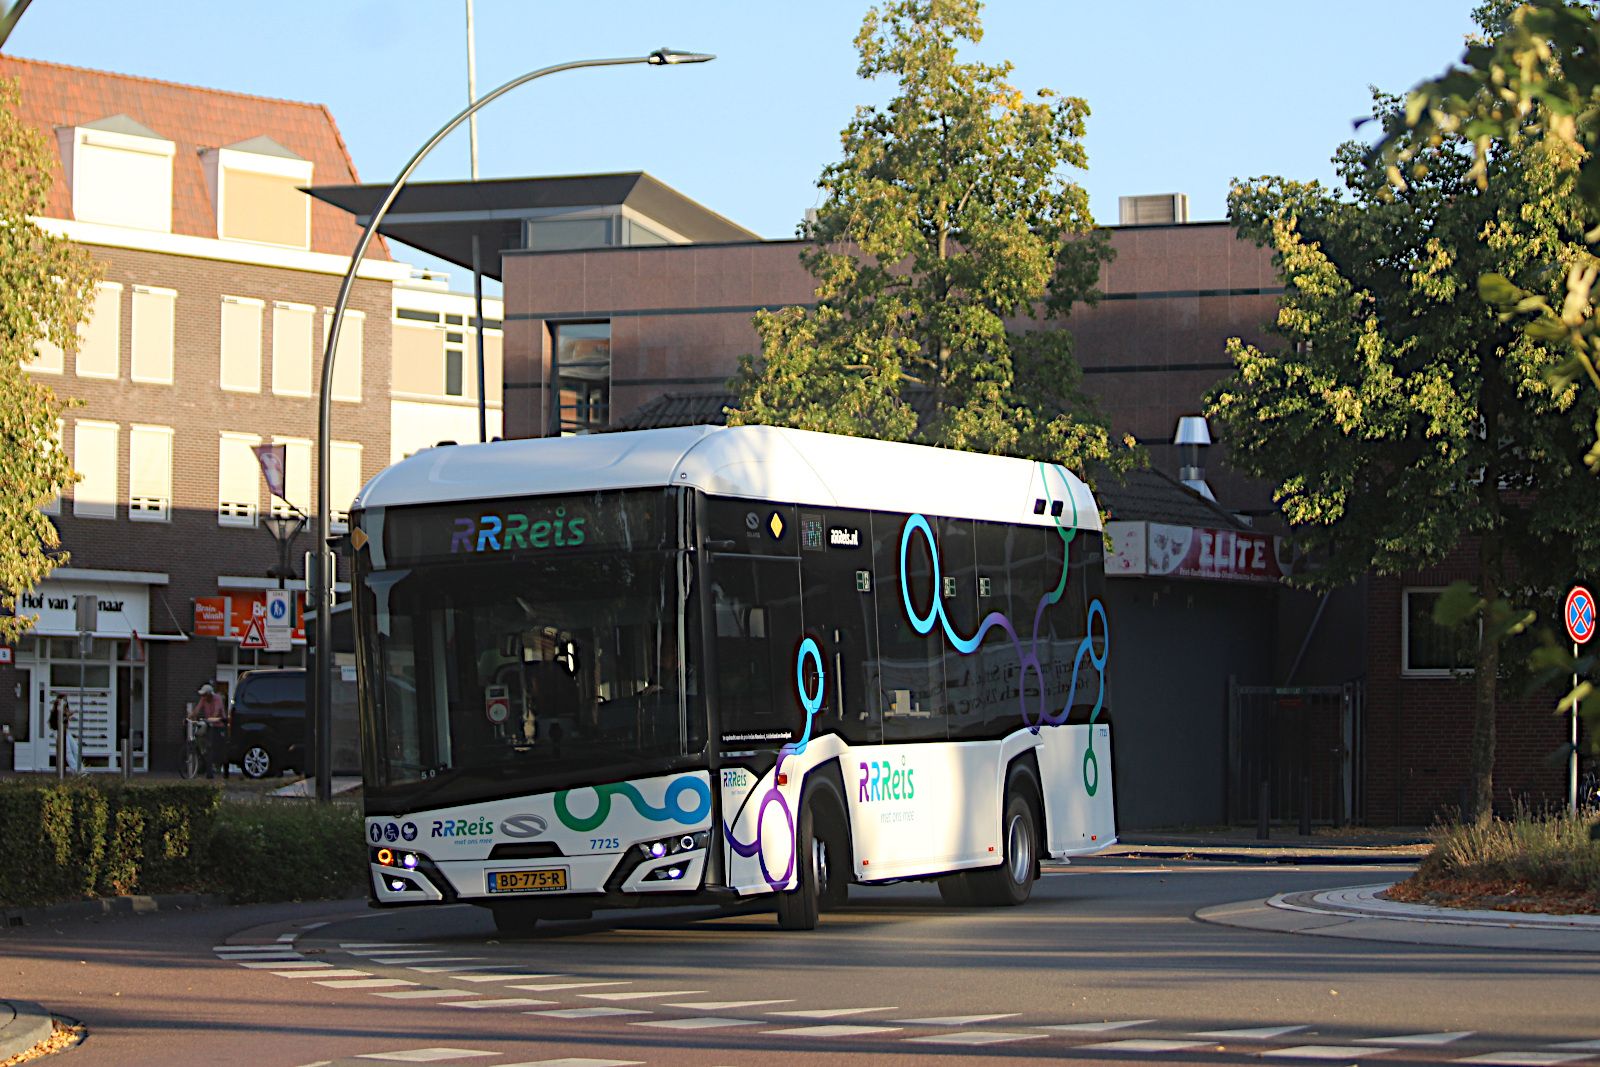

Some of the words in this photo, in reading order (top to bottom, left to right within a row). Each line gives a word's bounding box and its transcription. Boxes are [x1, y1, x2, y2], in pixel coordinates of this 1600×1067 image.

[450, 506, 586, 553] RRReis
[1199, 531, 1267, 569] ELITE
[22, 591, 44, 609] Hof
[48, 597, 69, 610] van
[196, 603, 216, 612] Brain
[202, 610, 224, 620] Wash
[723, 768, 747, 787] RRReis
[859, 754, 915, 803] RRReis
[880, 812, 892, 823] met
[902, 810, 914, 821] mee
[431, 816, 494, 838] RRReis
[590, 838, 620, 850] 7725
[500, 872, 560, 887] BD-775-R
